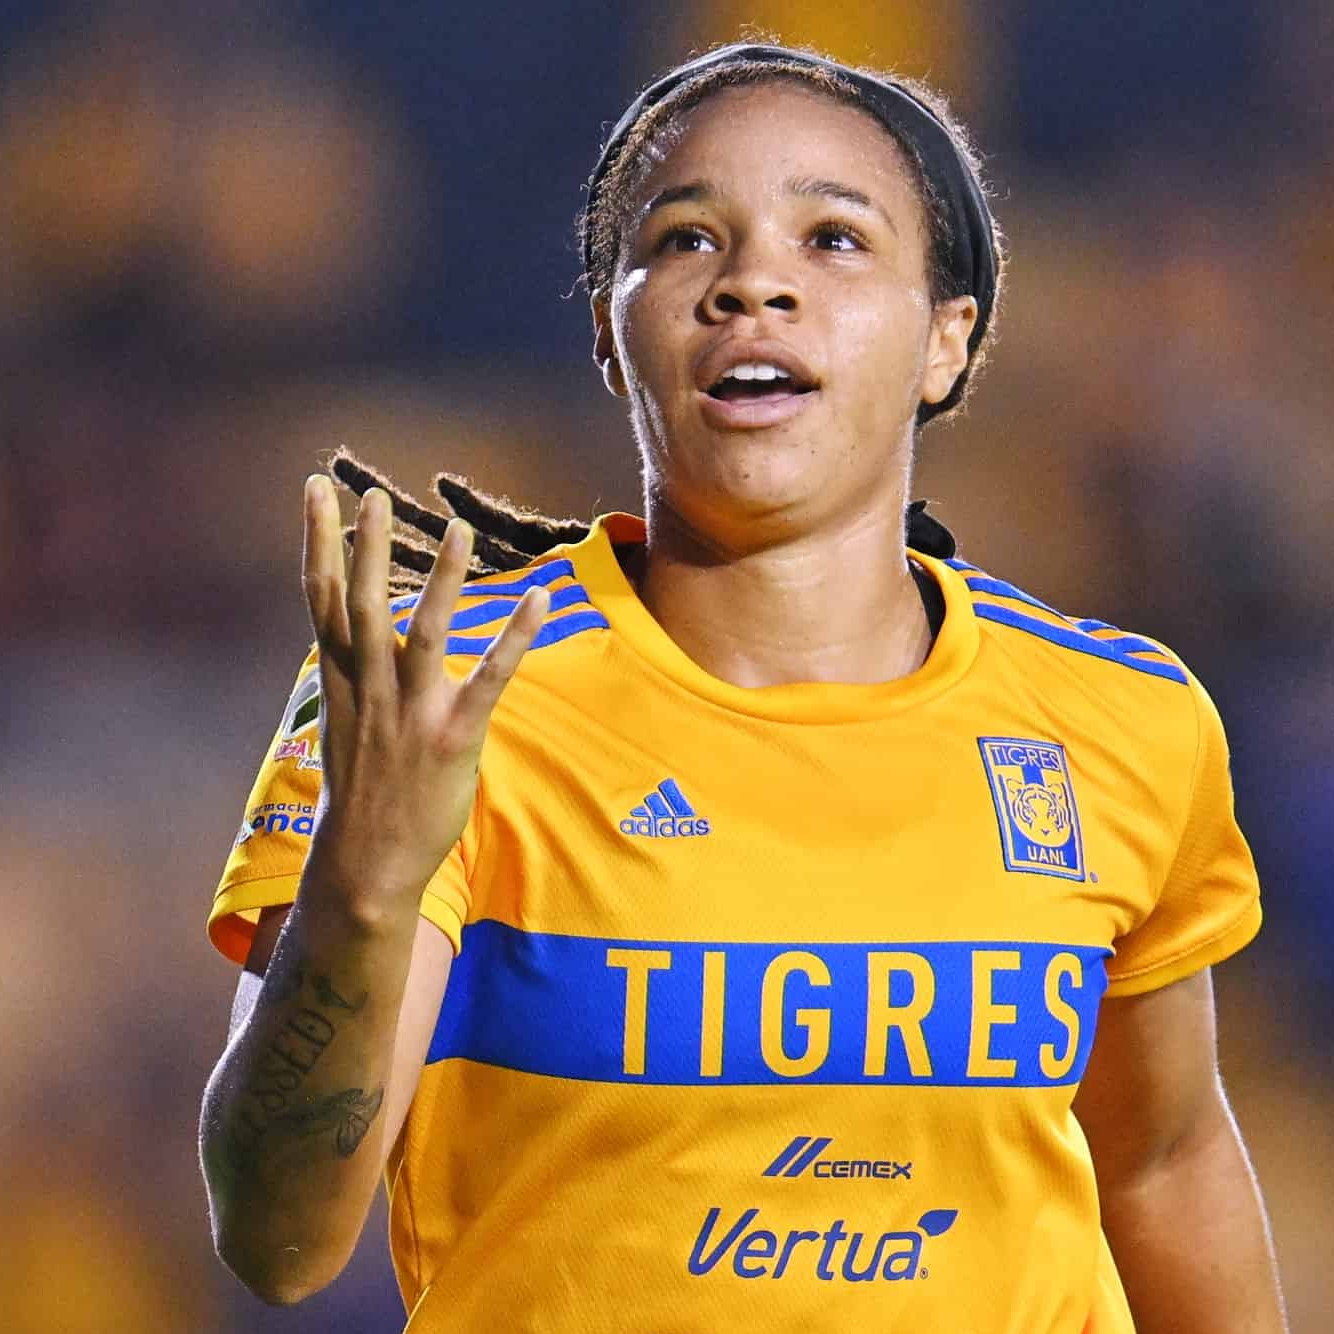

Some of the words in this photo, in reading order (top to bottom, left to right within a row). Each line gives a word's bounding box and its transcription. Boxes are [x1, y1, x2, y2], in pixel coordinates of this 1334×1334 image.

[990, 746, 1061, 771] TIGRES
[619, 814, 710, 838] adidas
[1026, 845, 1068, 866] UANL
[606, 948, 1084, 1079] TIGRES
[813, 1160, 913, 1180] CEMEX
[687, 1207, 925, 1282] Vertua
